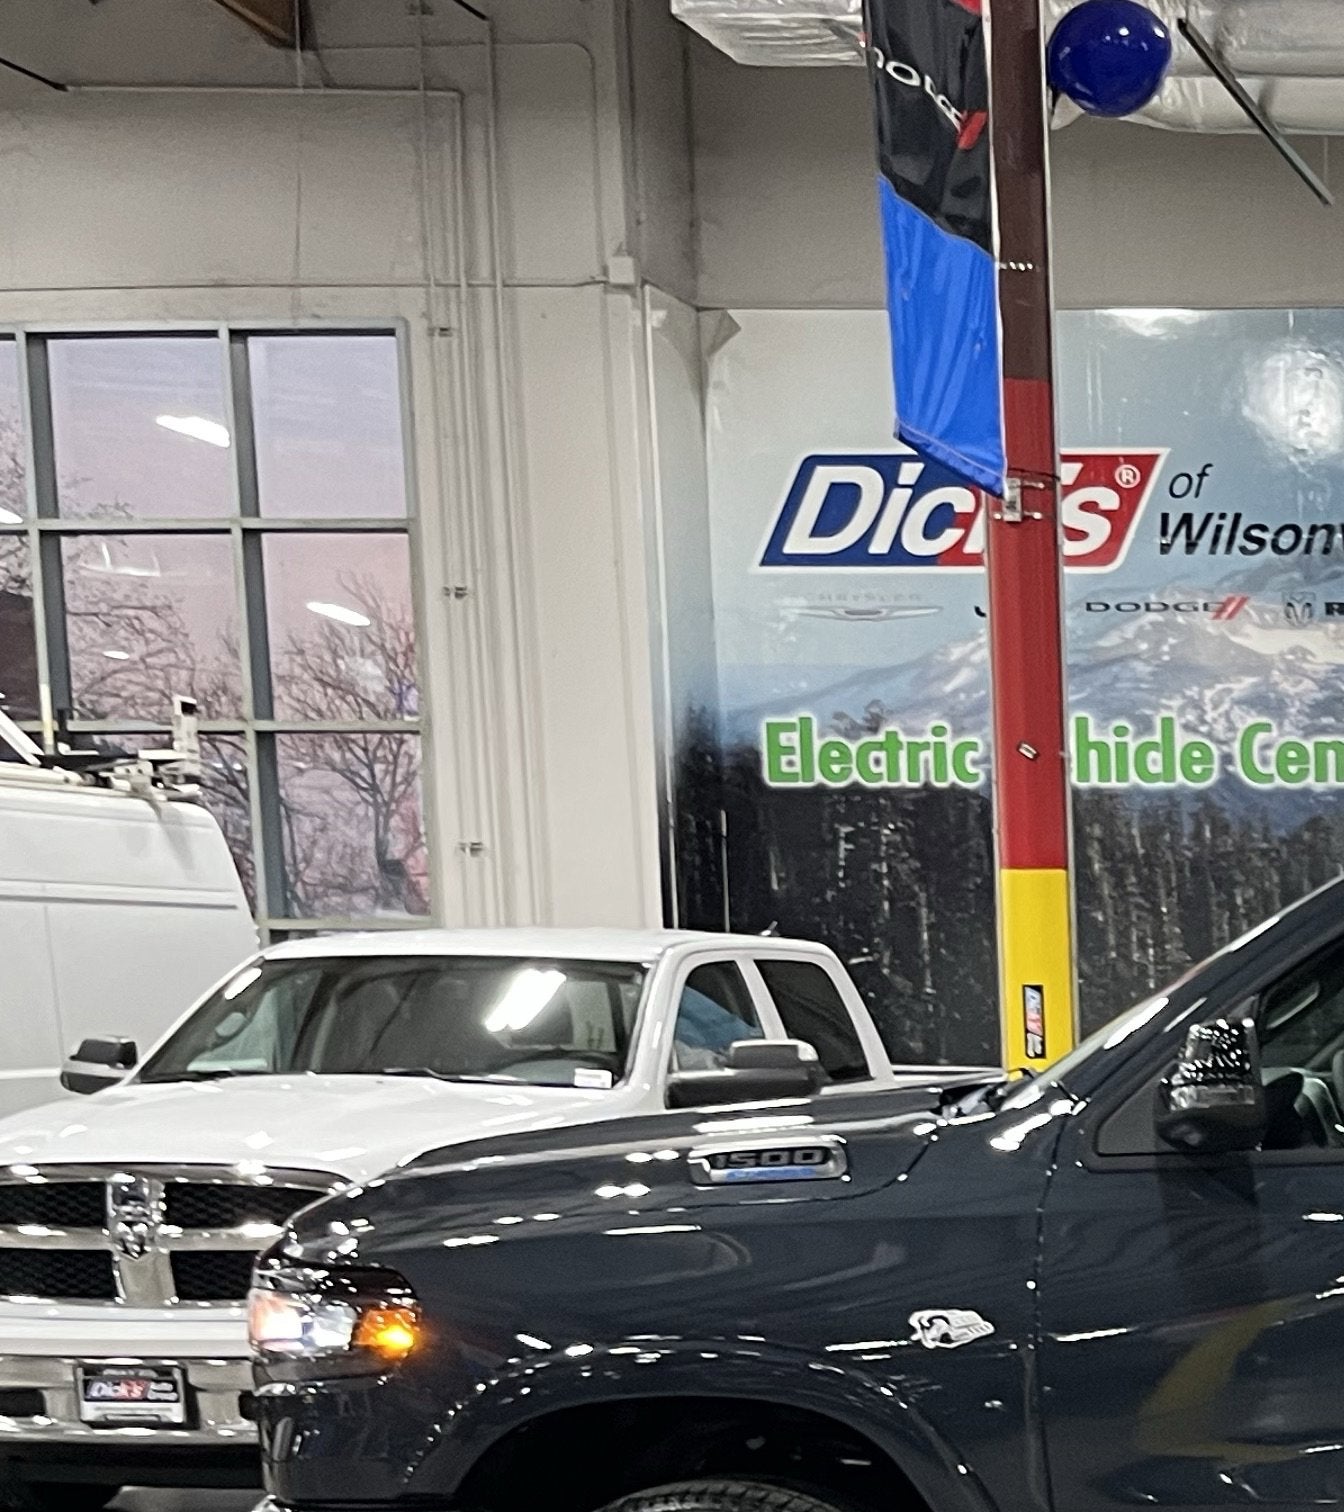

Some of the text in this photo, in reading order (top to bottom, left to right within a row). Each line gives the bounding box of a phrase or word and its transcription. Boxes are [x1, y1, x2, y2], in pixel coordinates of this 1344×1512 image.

[1168, 463, 1214, 499] of
[782, 463, 1121, 556] Dic's
[766, 716, 981, 783] Electric
[1075, 716, 1214, 784] hicle
[709, 1149, 823, 1169] 1500
